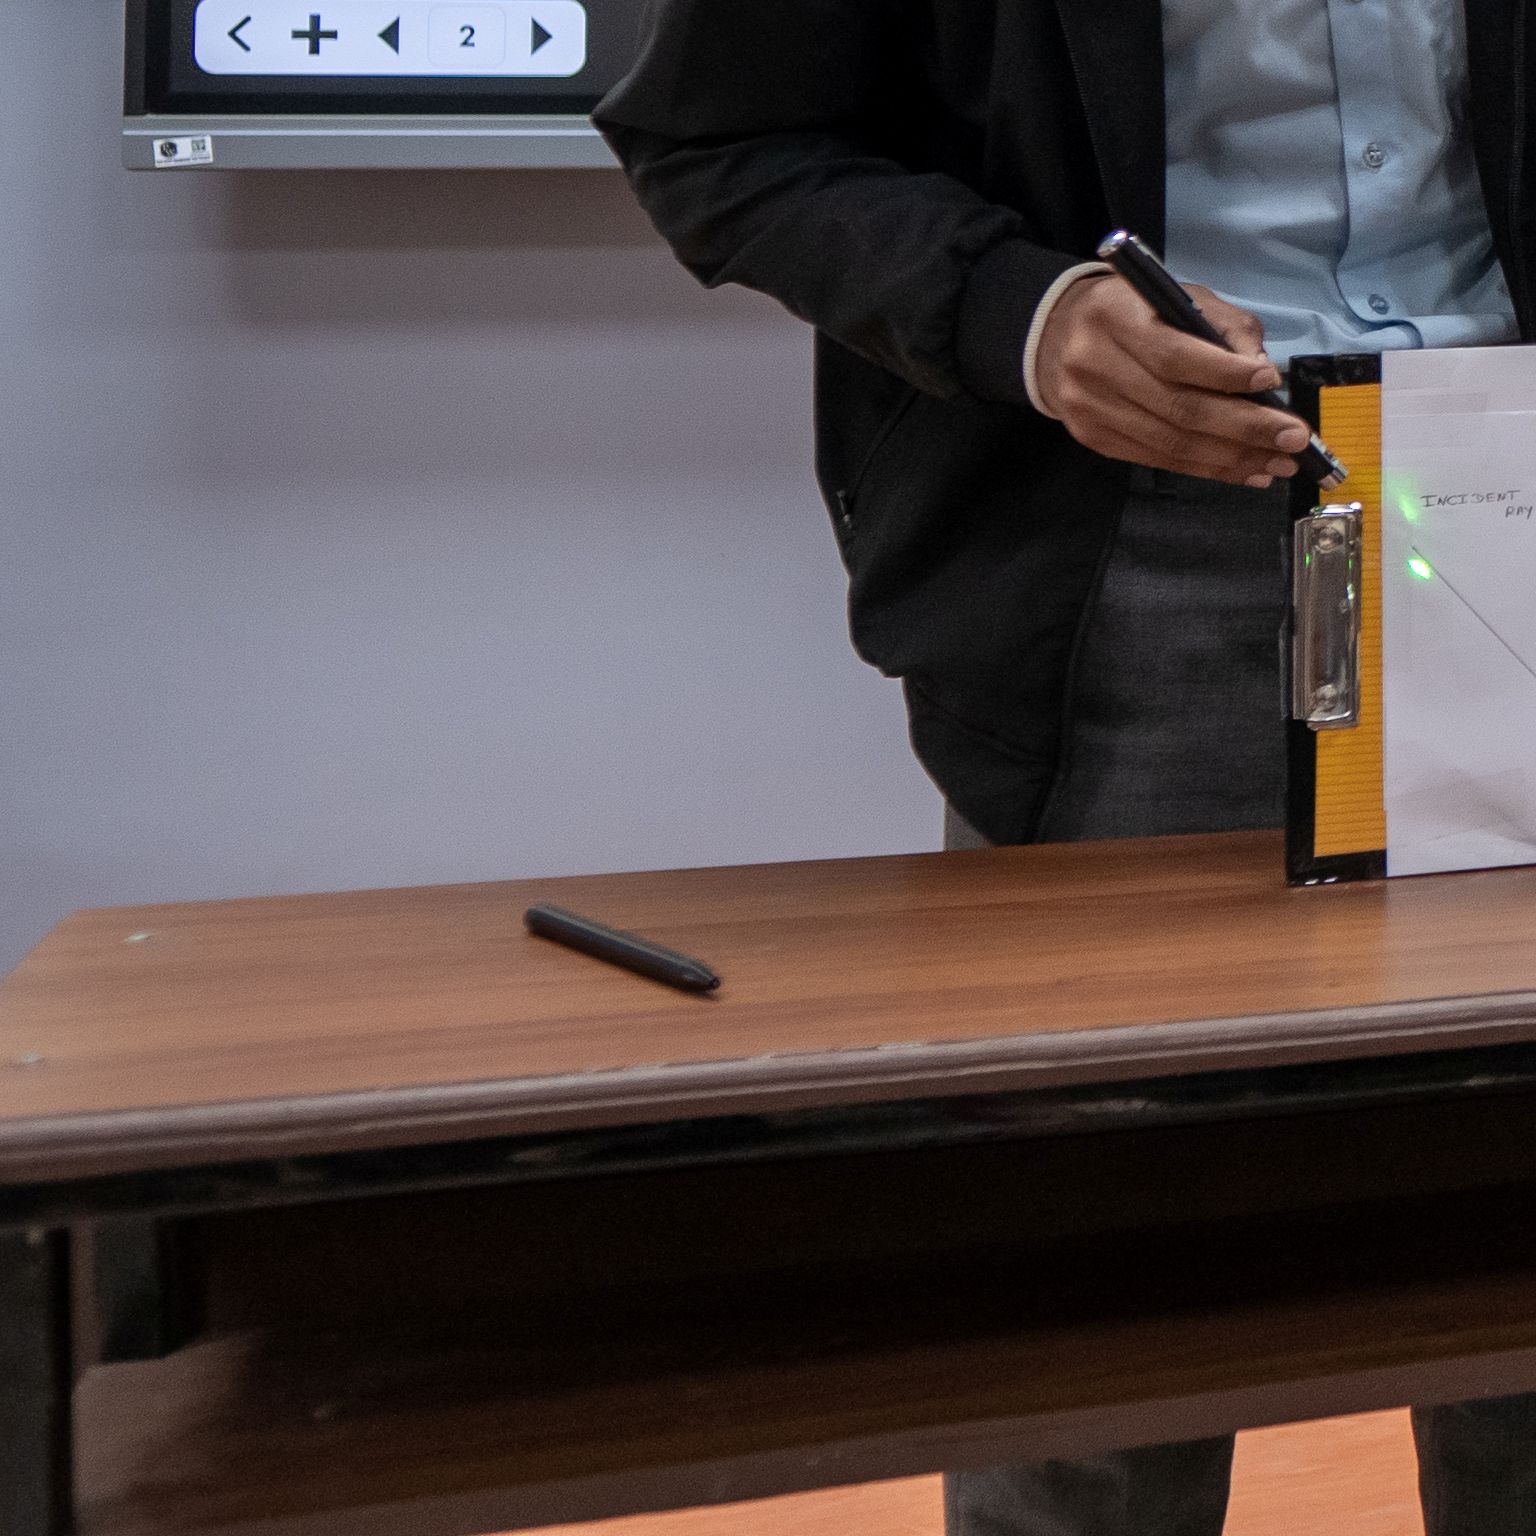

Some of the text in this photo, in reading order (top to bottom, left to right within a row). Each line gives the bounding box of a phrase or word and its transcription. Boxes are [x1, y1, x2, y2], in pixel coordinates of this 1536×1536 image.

[458, 24, 476, 48] 2
[1419, 489, 1521, 508] INCIDENT
[1504, 505, 1534, 520] RAY
